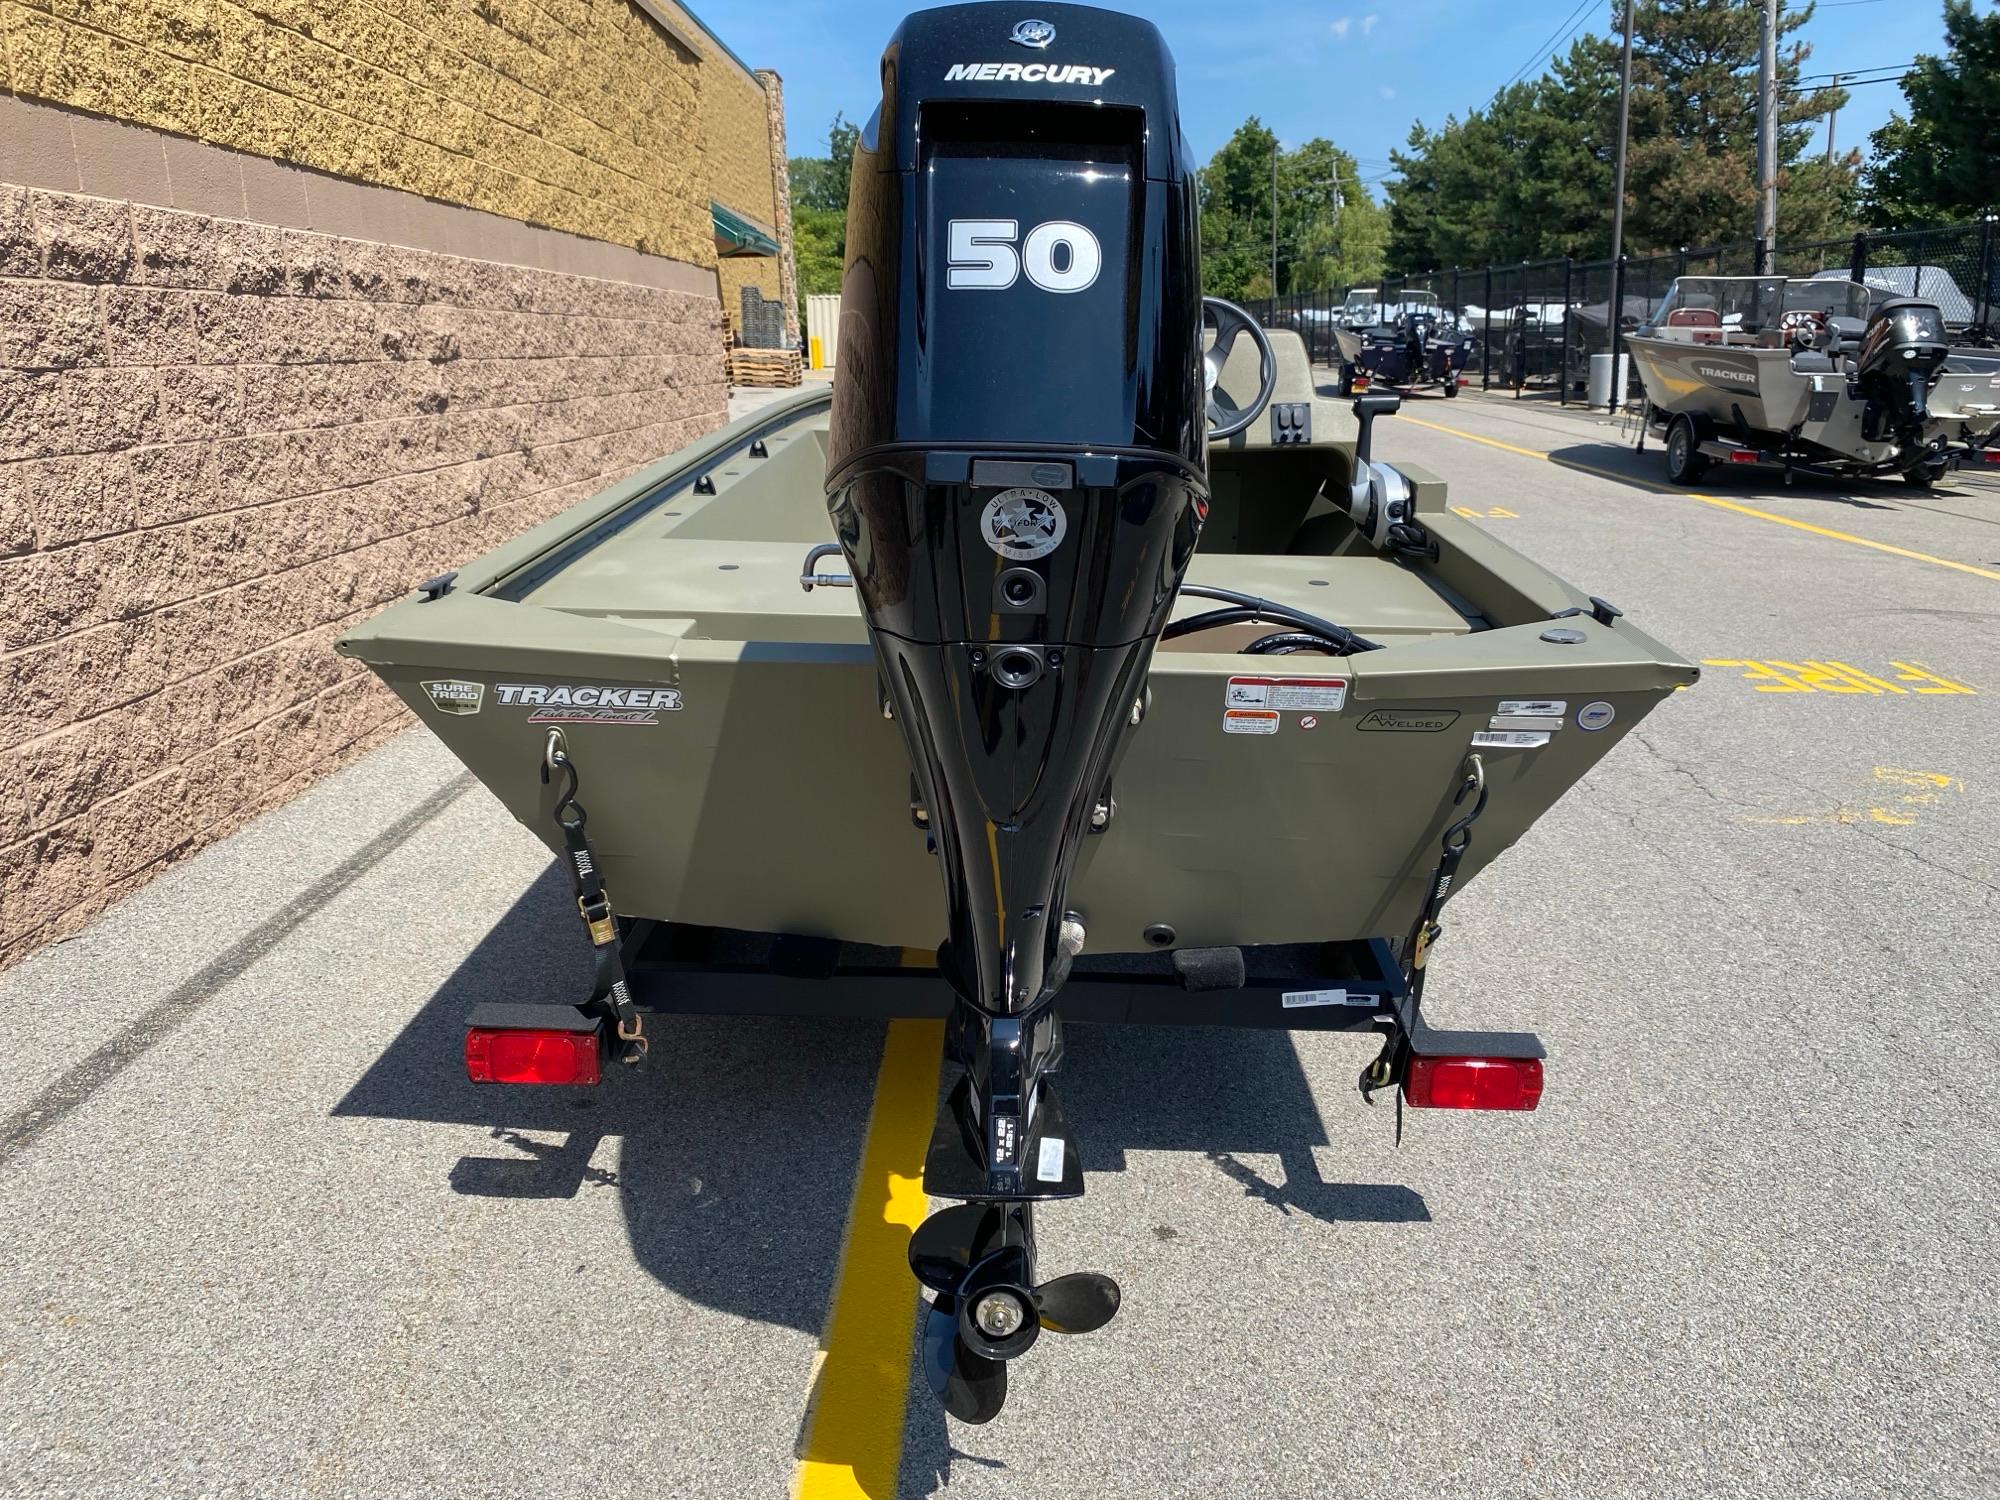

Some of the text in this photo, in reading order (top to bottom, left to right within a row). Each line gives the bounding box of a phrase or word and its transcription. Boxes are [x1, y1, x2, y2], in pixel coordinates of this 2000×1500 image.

[944, 63, 1116, 86] MERCURY
[946, 218, 1102, 293] 50
[1699, 367, 1756, 383] TRACKER
[1035, 491, 1059, 510] LOW
[1699, 658, 1978, 696] FIRE
[430, 690, 479, 700] TREAD
[432, 683, 473, 692] SURE
[497, 685, 682, 709] TRACKER
[533, 709, 564, 719] Fish
[566, 710, 590, 719] the
[1367, 713, 1397, 724] ALL
[1380, 720, 1444, 728] WELDED
[997, 1119, 1006, 1137] 22
[996, 1149, 1005, 1163] 12
